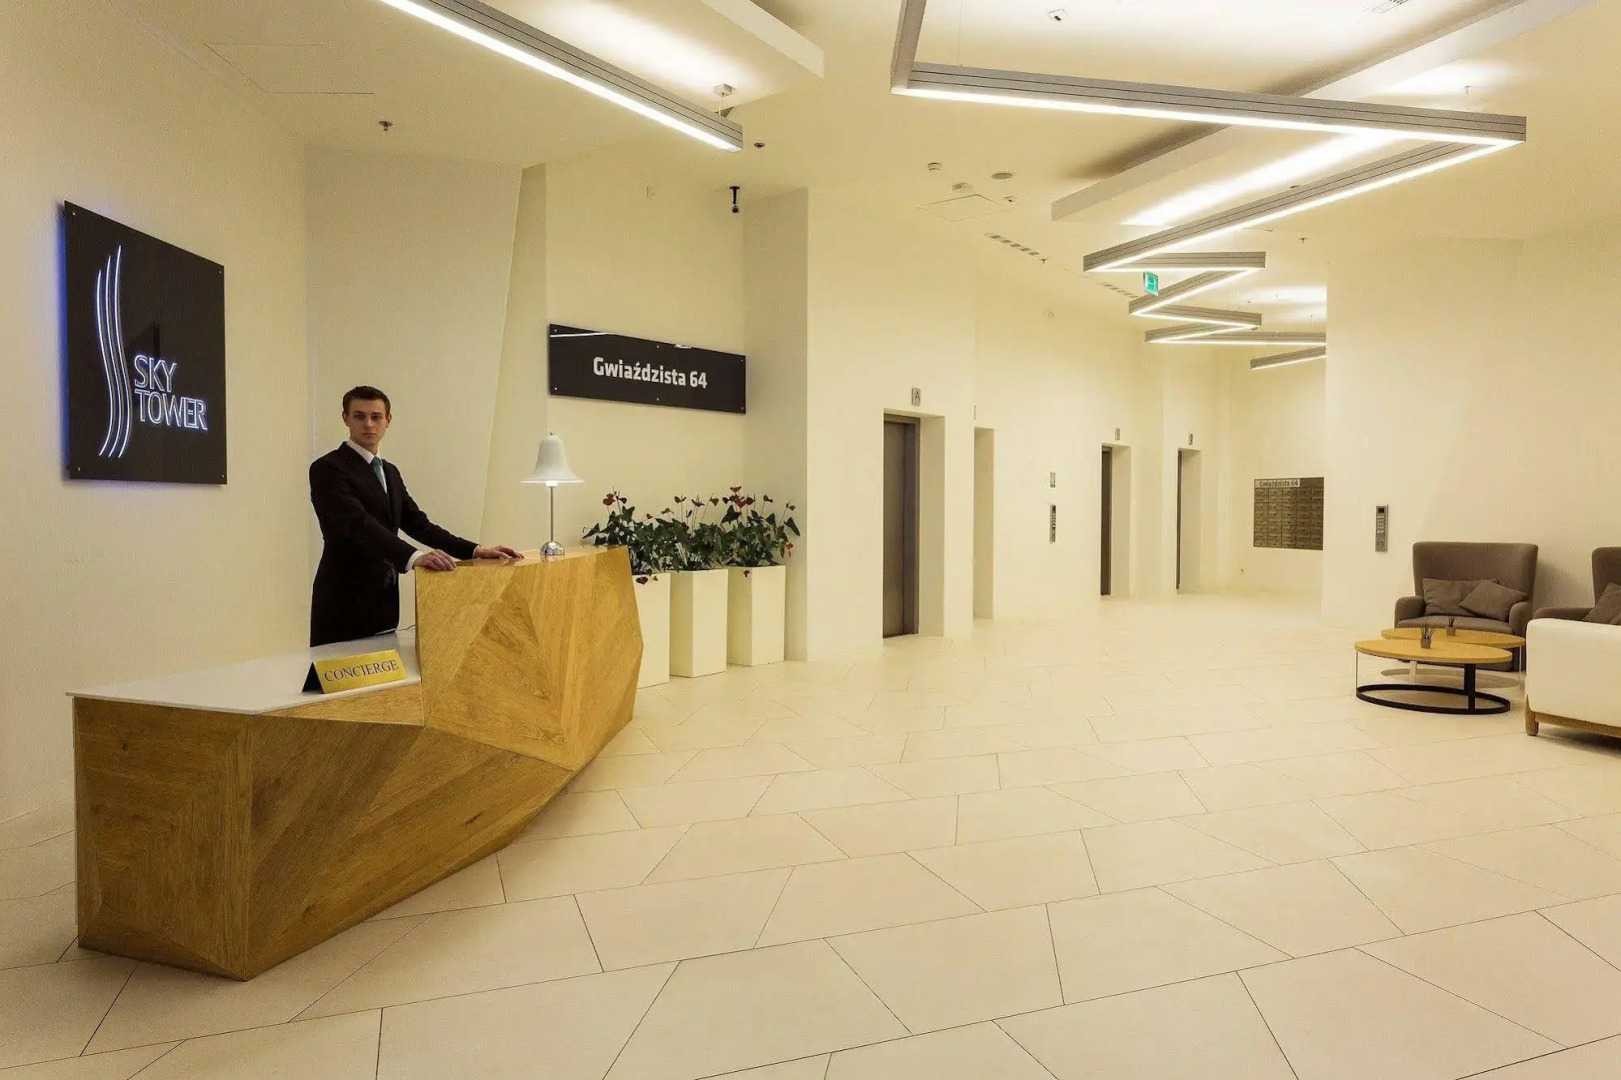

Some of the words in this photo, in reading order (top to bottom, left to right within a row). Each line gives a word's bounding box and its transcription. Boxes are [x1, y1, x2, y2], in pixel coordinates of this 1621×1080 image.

[134, 354, 177, 393] SKY
[593, 356, 687, 386] Gwiaździsta
[689, 371, 708, 389] 64
[134, 388, 208, 430] TOWER
[323, 659, 399, 682] CONCIERGE
